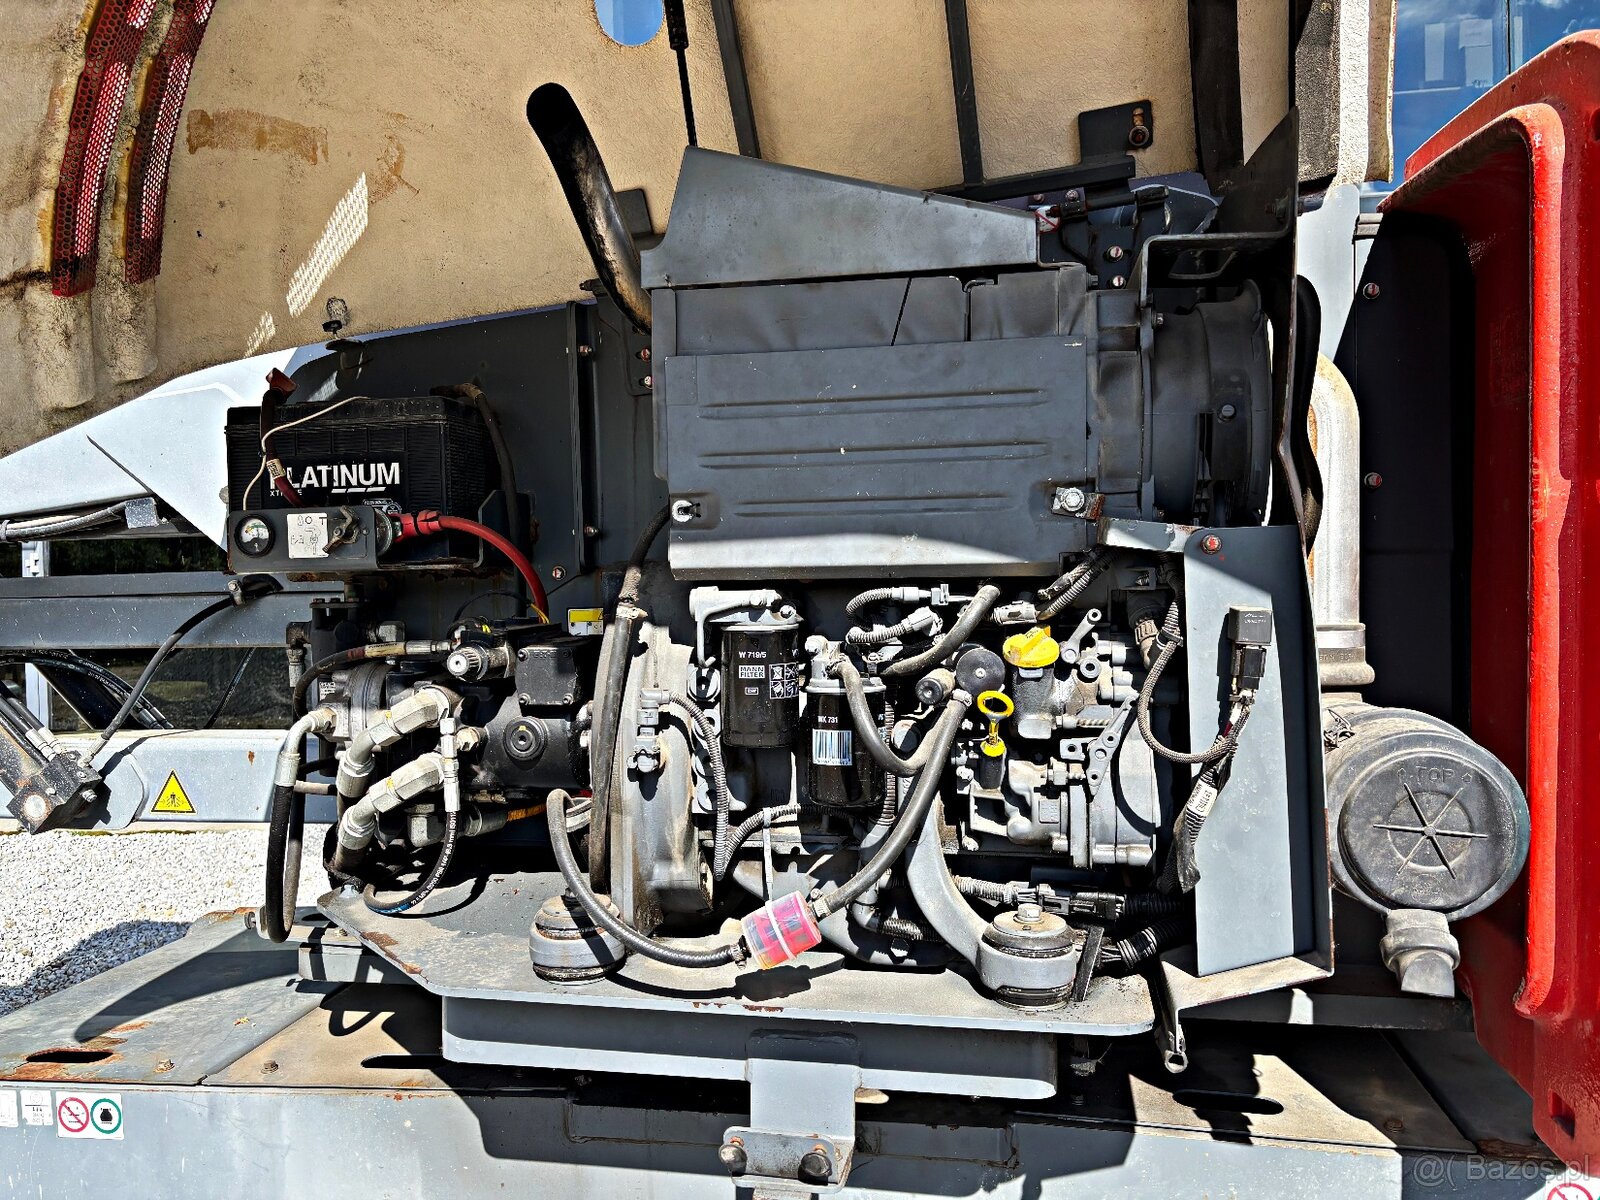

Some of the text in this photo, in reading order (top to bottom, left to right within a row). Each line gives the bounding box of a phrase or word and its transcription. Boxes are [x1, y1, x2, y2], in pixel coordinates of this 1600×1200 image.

[270, 462, 400, 490] LATINUM
[738, 651, 767, 659] W 719/5
[828, 716, 838, 724] 731
[1415, 765, 1456, 784] TOP
